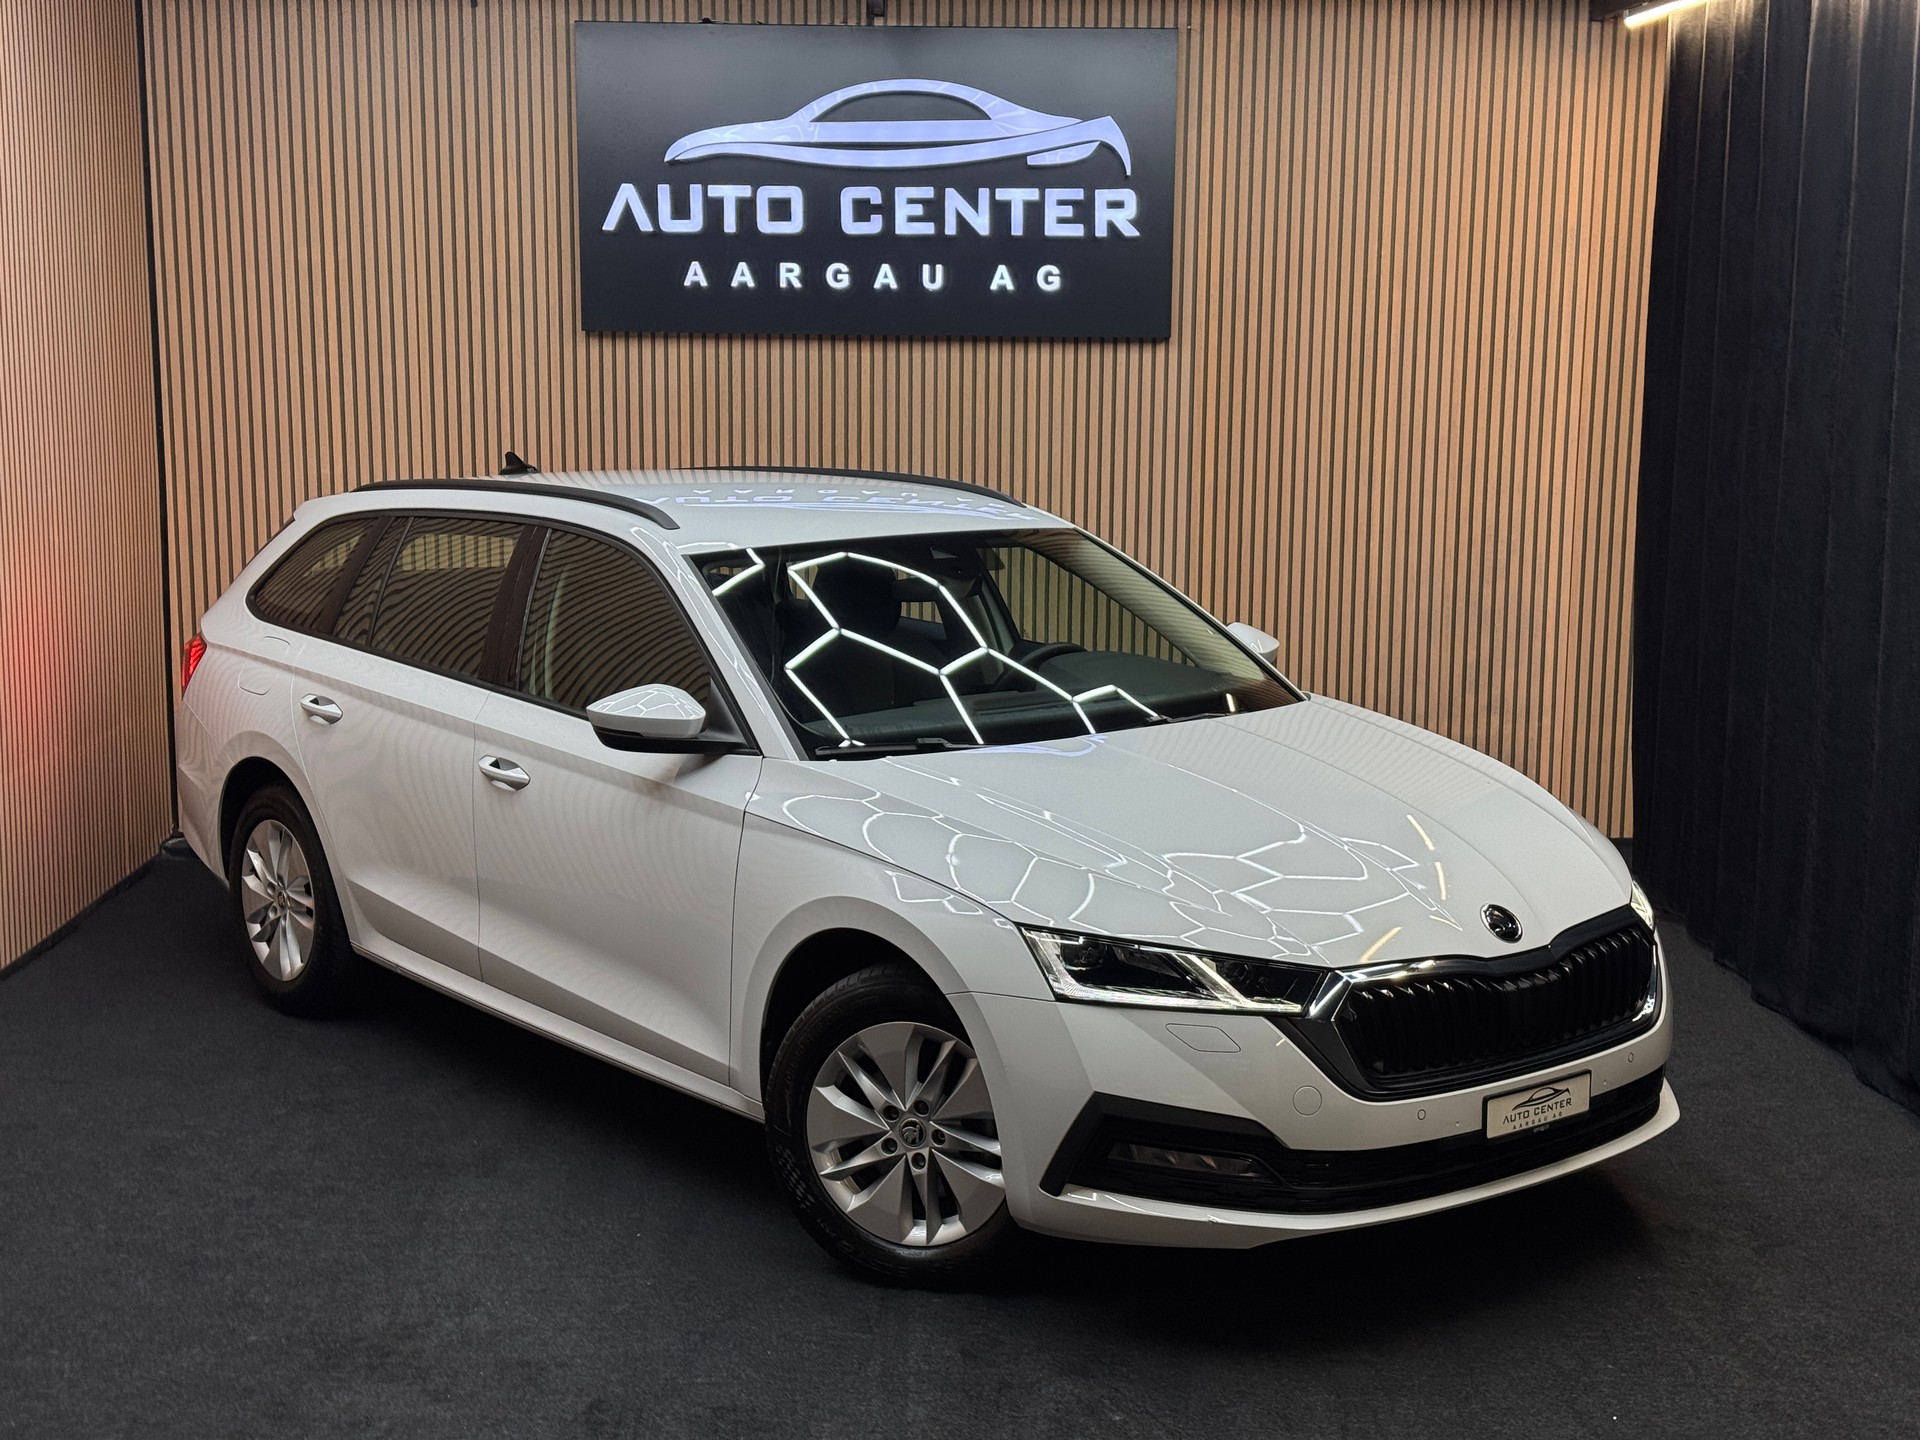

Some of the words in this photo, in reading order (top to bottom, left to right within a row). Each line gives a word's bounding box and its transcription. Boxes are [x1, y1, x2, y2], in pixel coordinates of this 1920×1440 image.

[602, 183, 805, 235] AUTO
[840, 186, 1141, 237] CENTER
[684, 261, 945, 291] AARGAU
[990, 264, 1061, 291] AG
[1503, 1109, 1530, 1125] AUTO
[1533, 1097, 1572, 1116] CENTER
